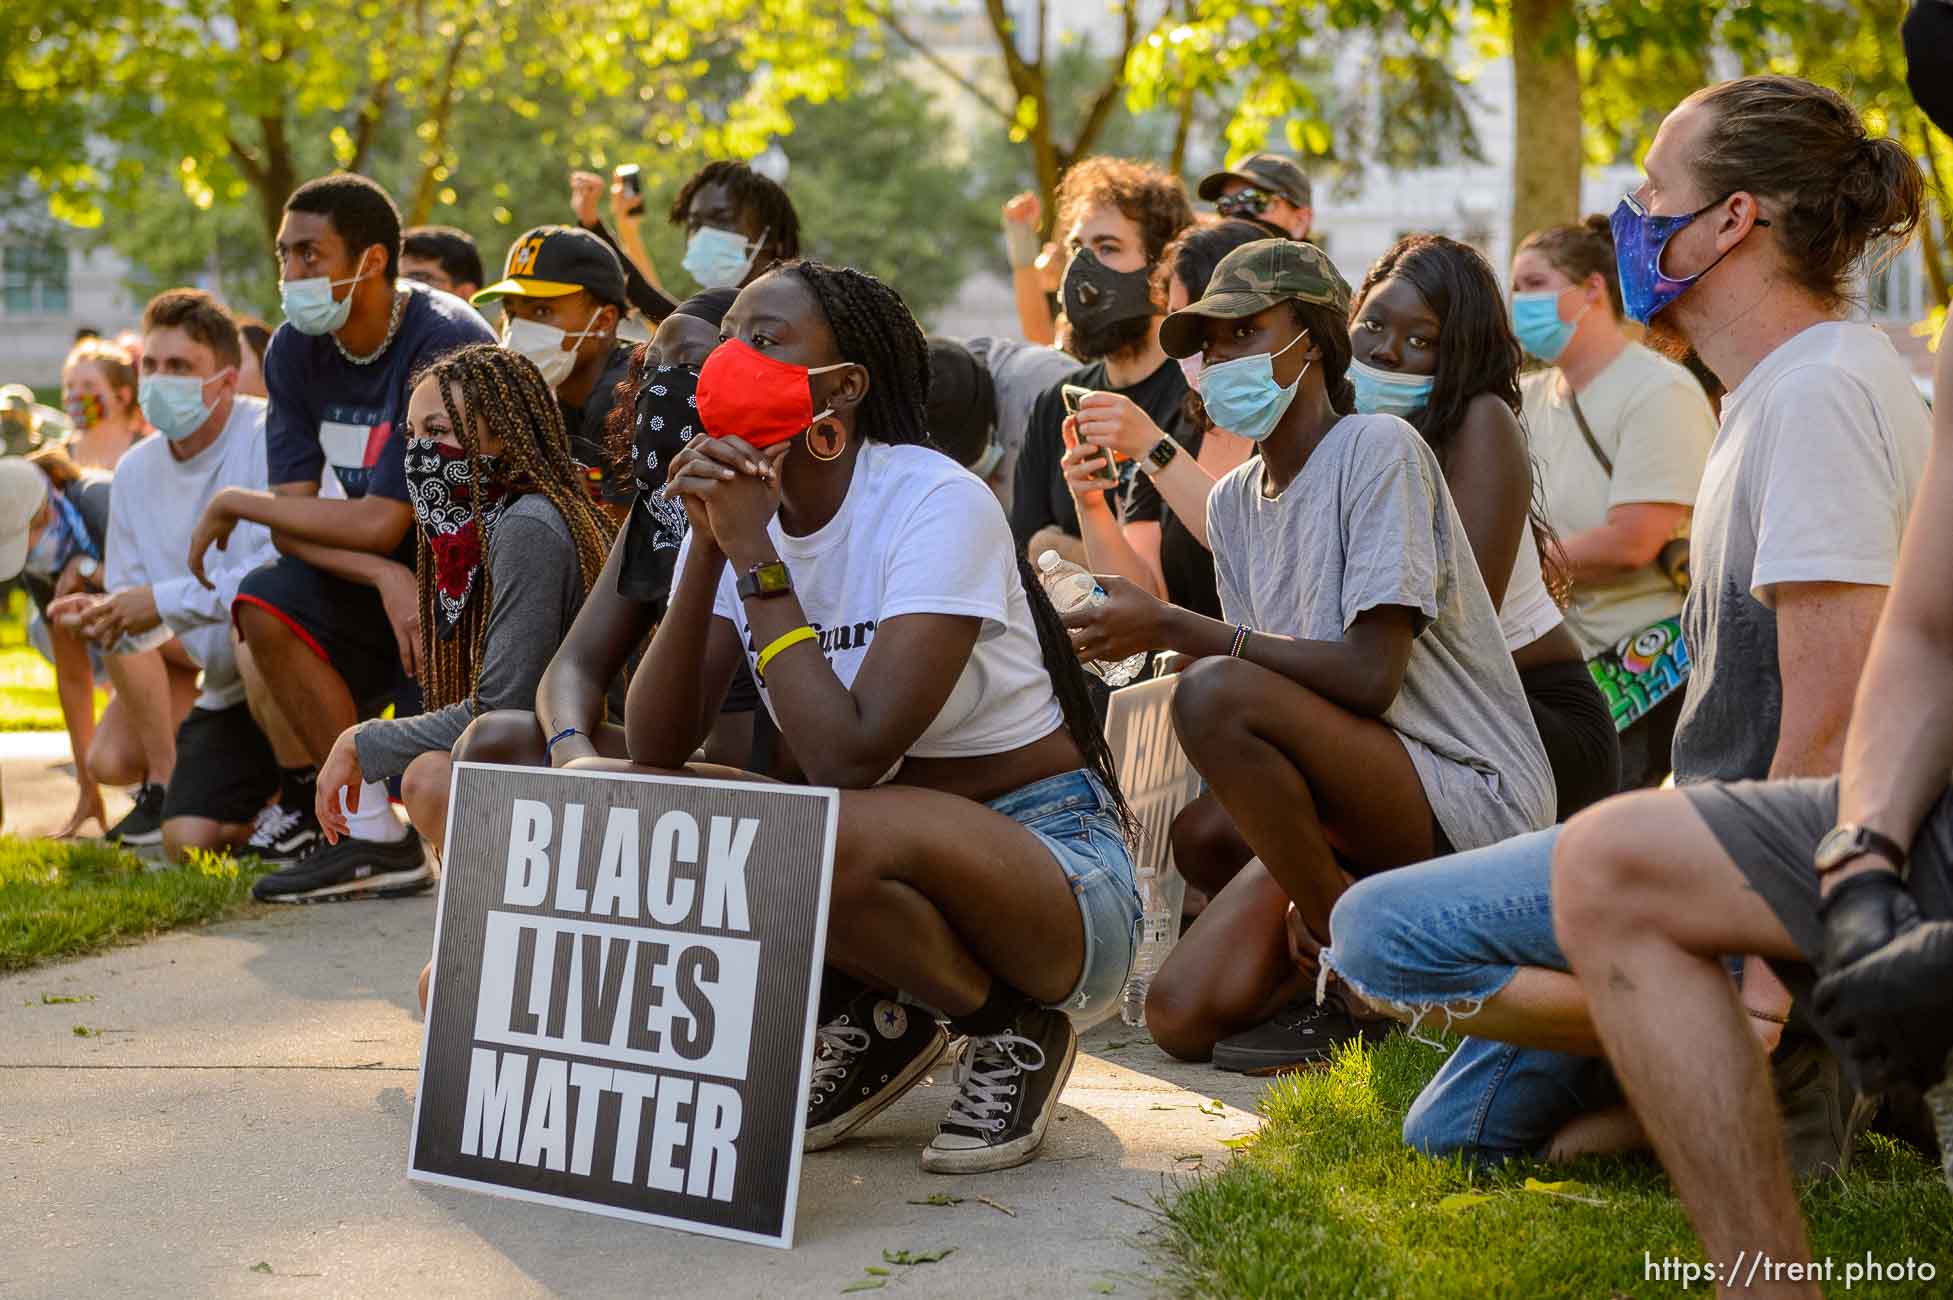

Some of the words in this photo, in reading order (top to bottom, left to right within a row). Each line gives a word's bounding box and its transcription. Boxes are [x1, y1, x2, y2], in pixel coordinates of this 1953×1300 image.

[503, 798, 760, 932] BLACK
[508, 926, 721, 1060] LIVES
[460, 1047, 743, 1202] MATTER
